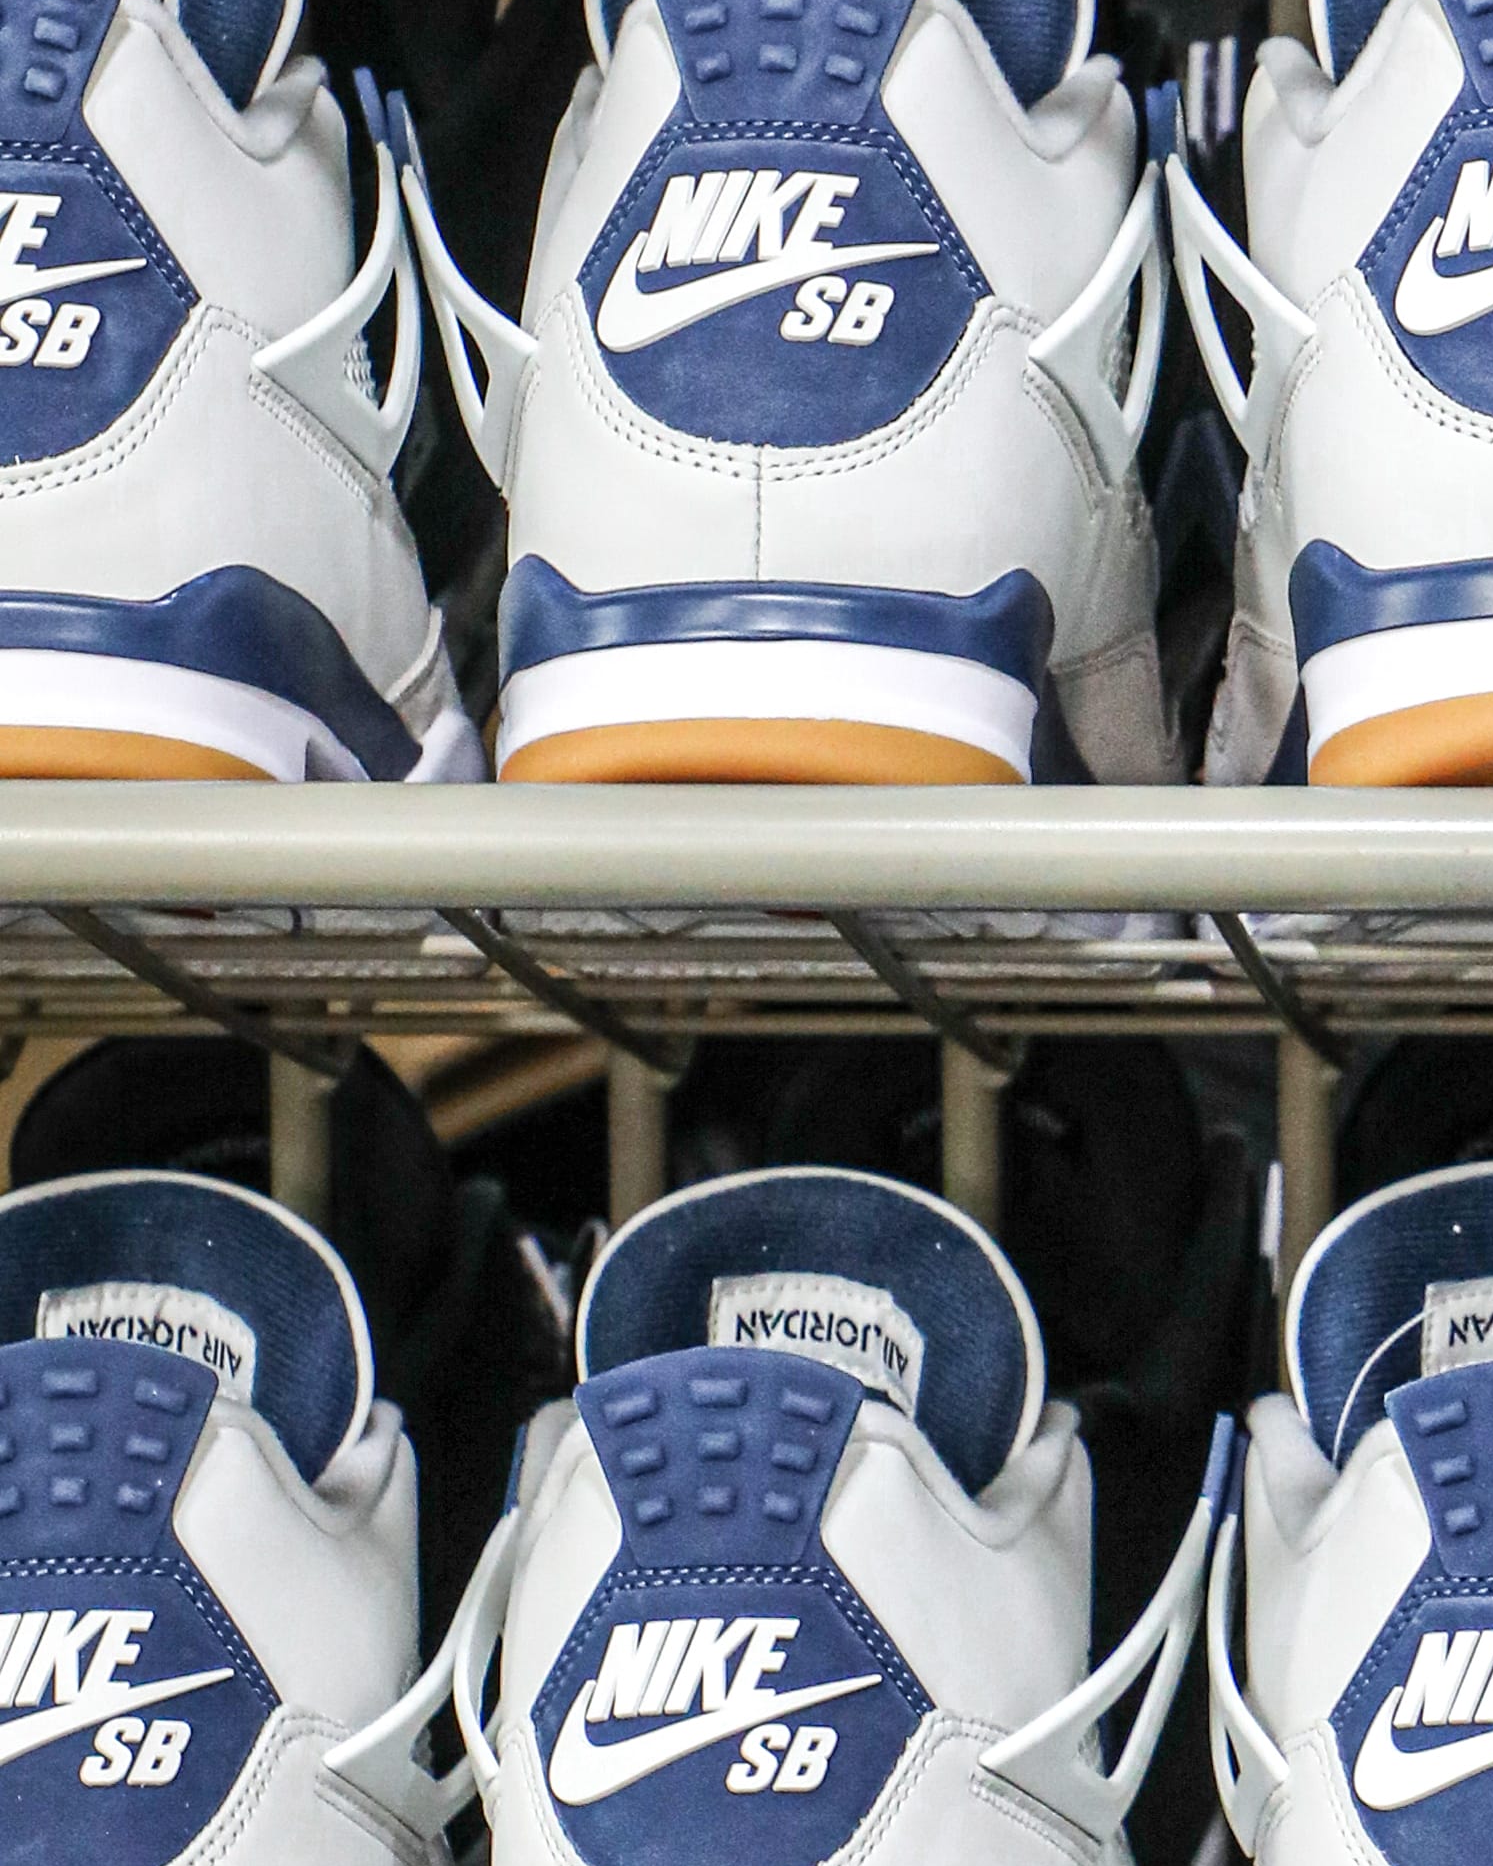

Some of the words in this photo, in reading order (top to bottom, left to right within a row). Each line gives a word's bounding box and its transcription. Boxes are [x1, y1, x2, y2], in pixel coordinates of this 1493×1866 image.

[640, 168, 858, 272] NIKE
[0, 298, 101, 369] SB
[778, 273, 897, 348] SB
[203, 1331, 241, 1378] AIR
[735, 1309, 882, 1352] JORDAN
[882, 1335, 909, 1374] AI
[0, 1608, 155, 1709] IKE
[586, 1616, 803, 1723] NIKE
[78, 1716, 192, 1789] SB
[723, 1721, 840, 1795] SB
